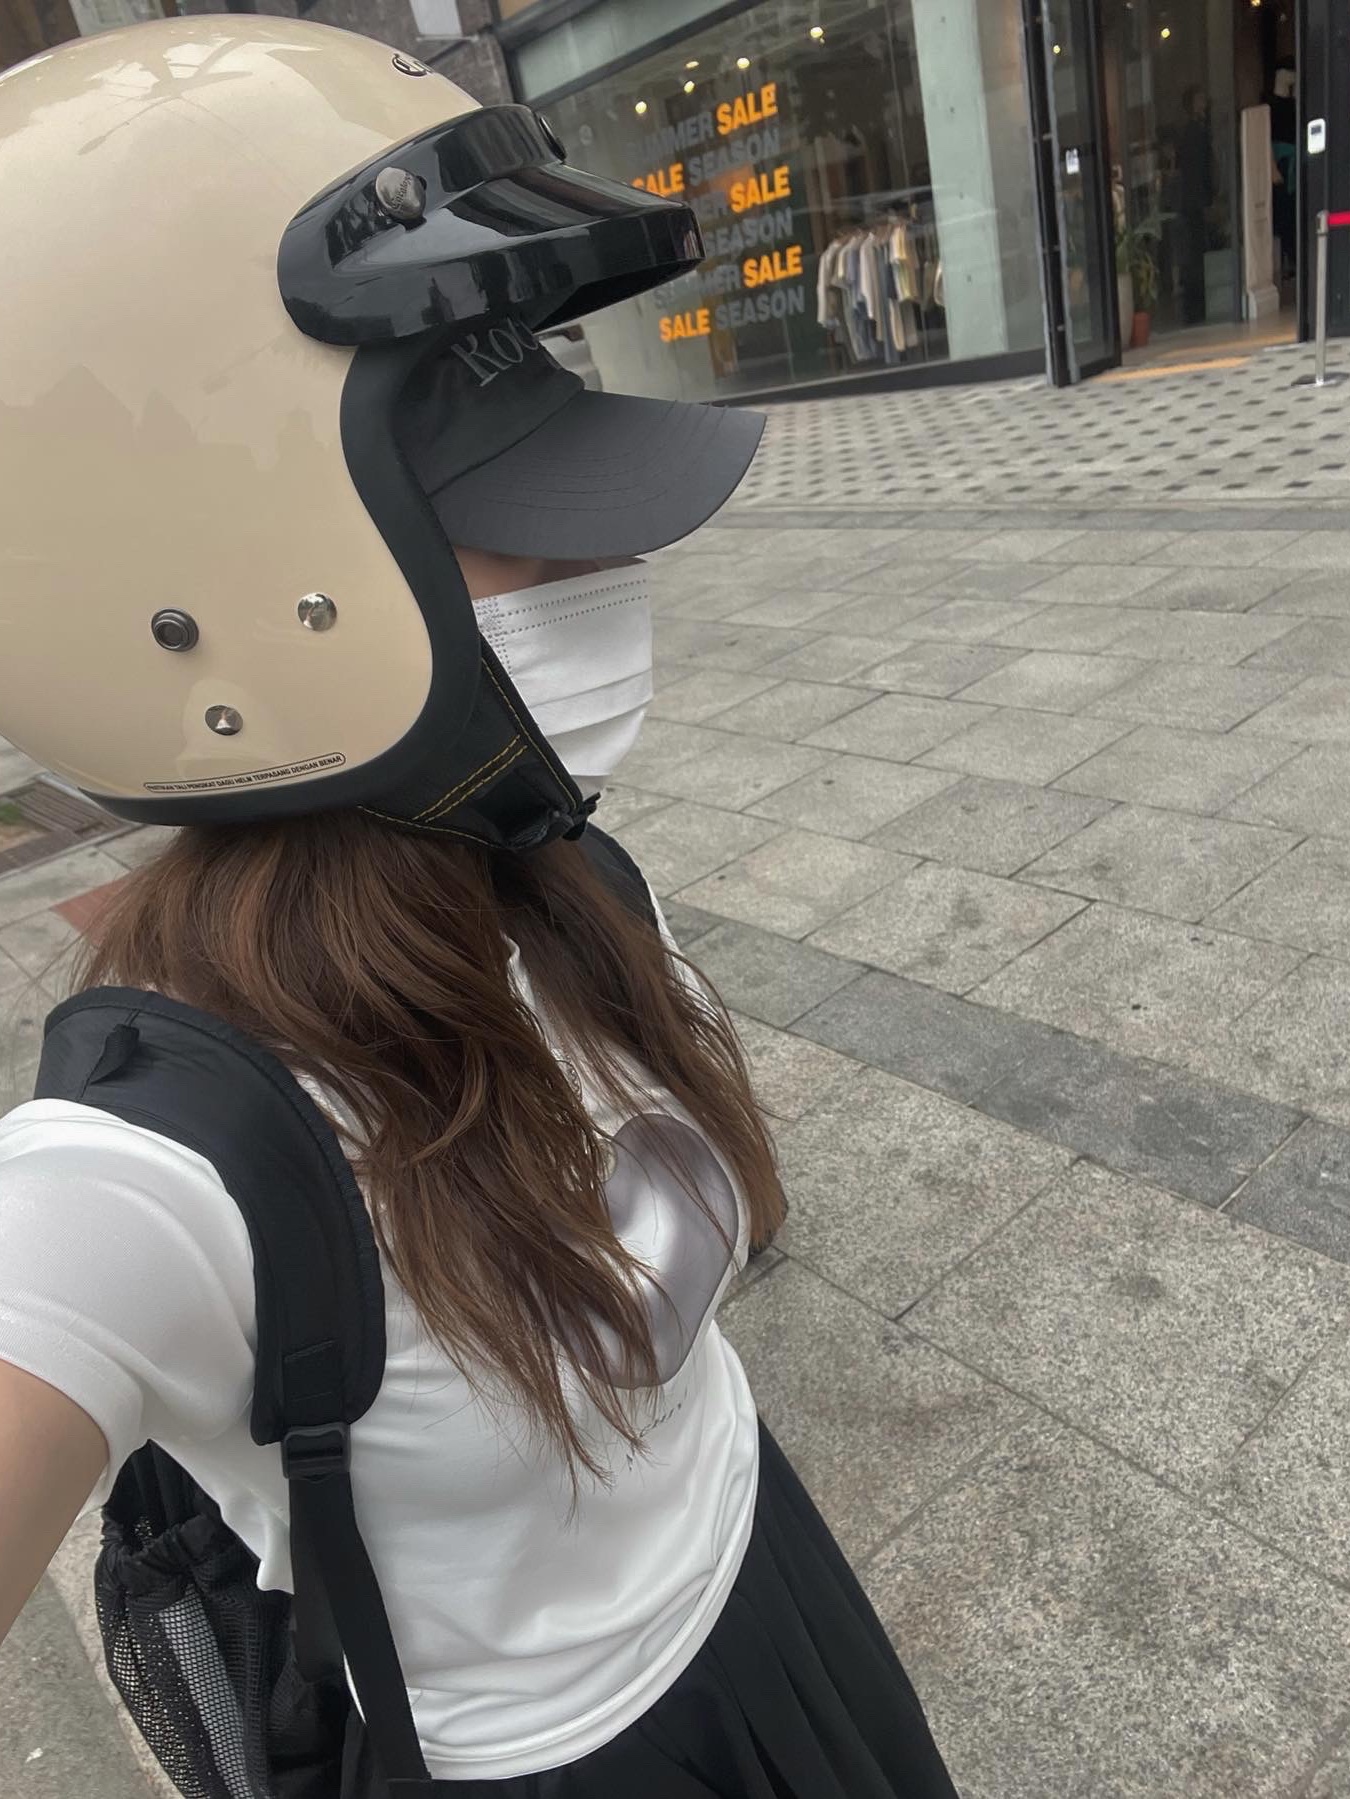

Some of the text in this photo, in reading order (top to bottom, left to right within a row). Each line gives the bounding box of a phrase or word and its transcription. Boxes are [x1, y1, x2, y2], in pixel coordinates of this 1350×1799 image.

[716, 82, 778, 135] SALE
[688, 128, 782, 186] SEASON
[730, 165, 791, 213] SALE
[742, 244, 804, 289] SALE
[658, 286, 806, 342] SALE SEASON
[216, 779, 235, 788] DAGU
[234, 775, 253, 786] HELM
[252, 768, 291, 782] TERPASANG
[291, 761, 319, 774] DENGAN
[318, 755, 342, 767] BENAR
